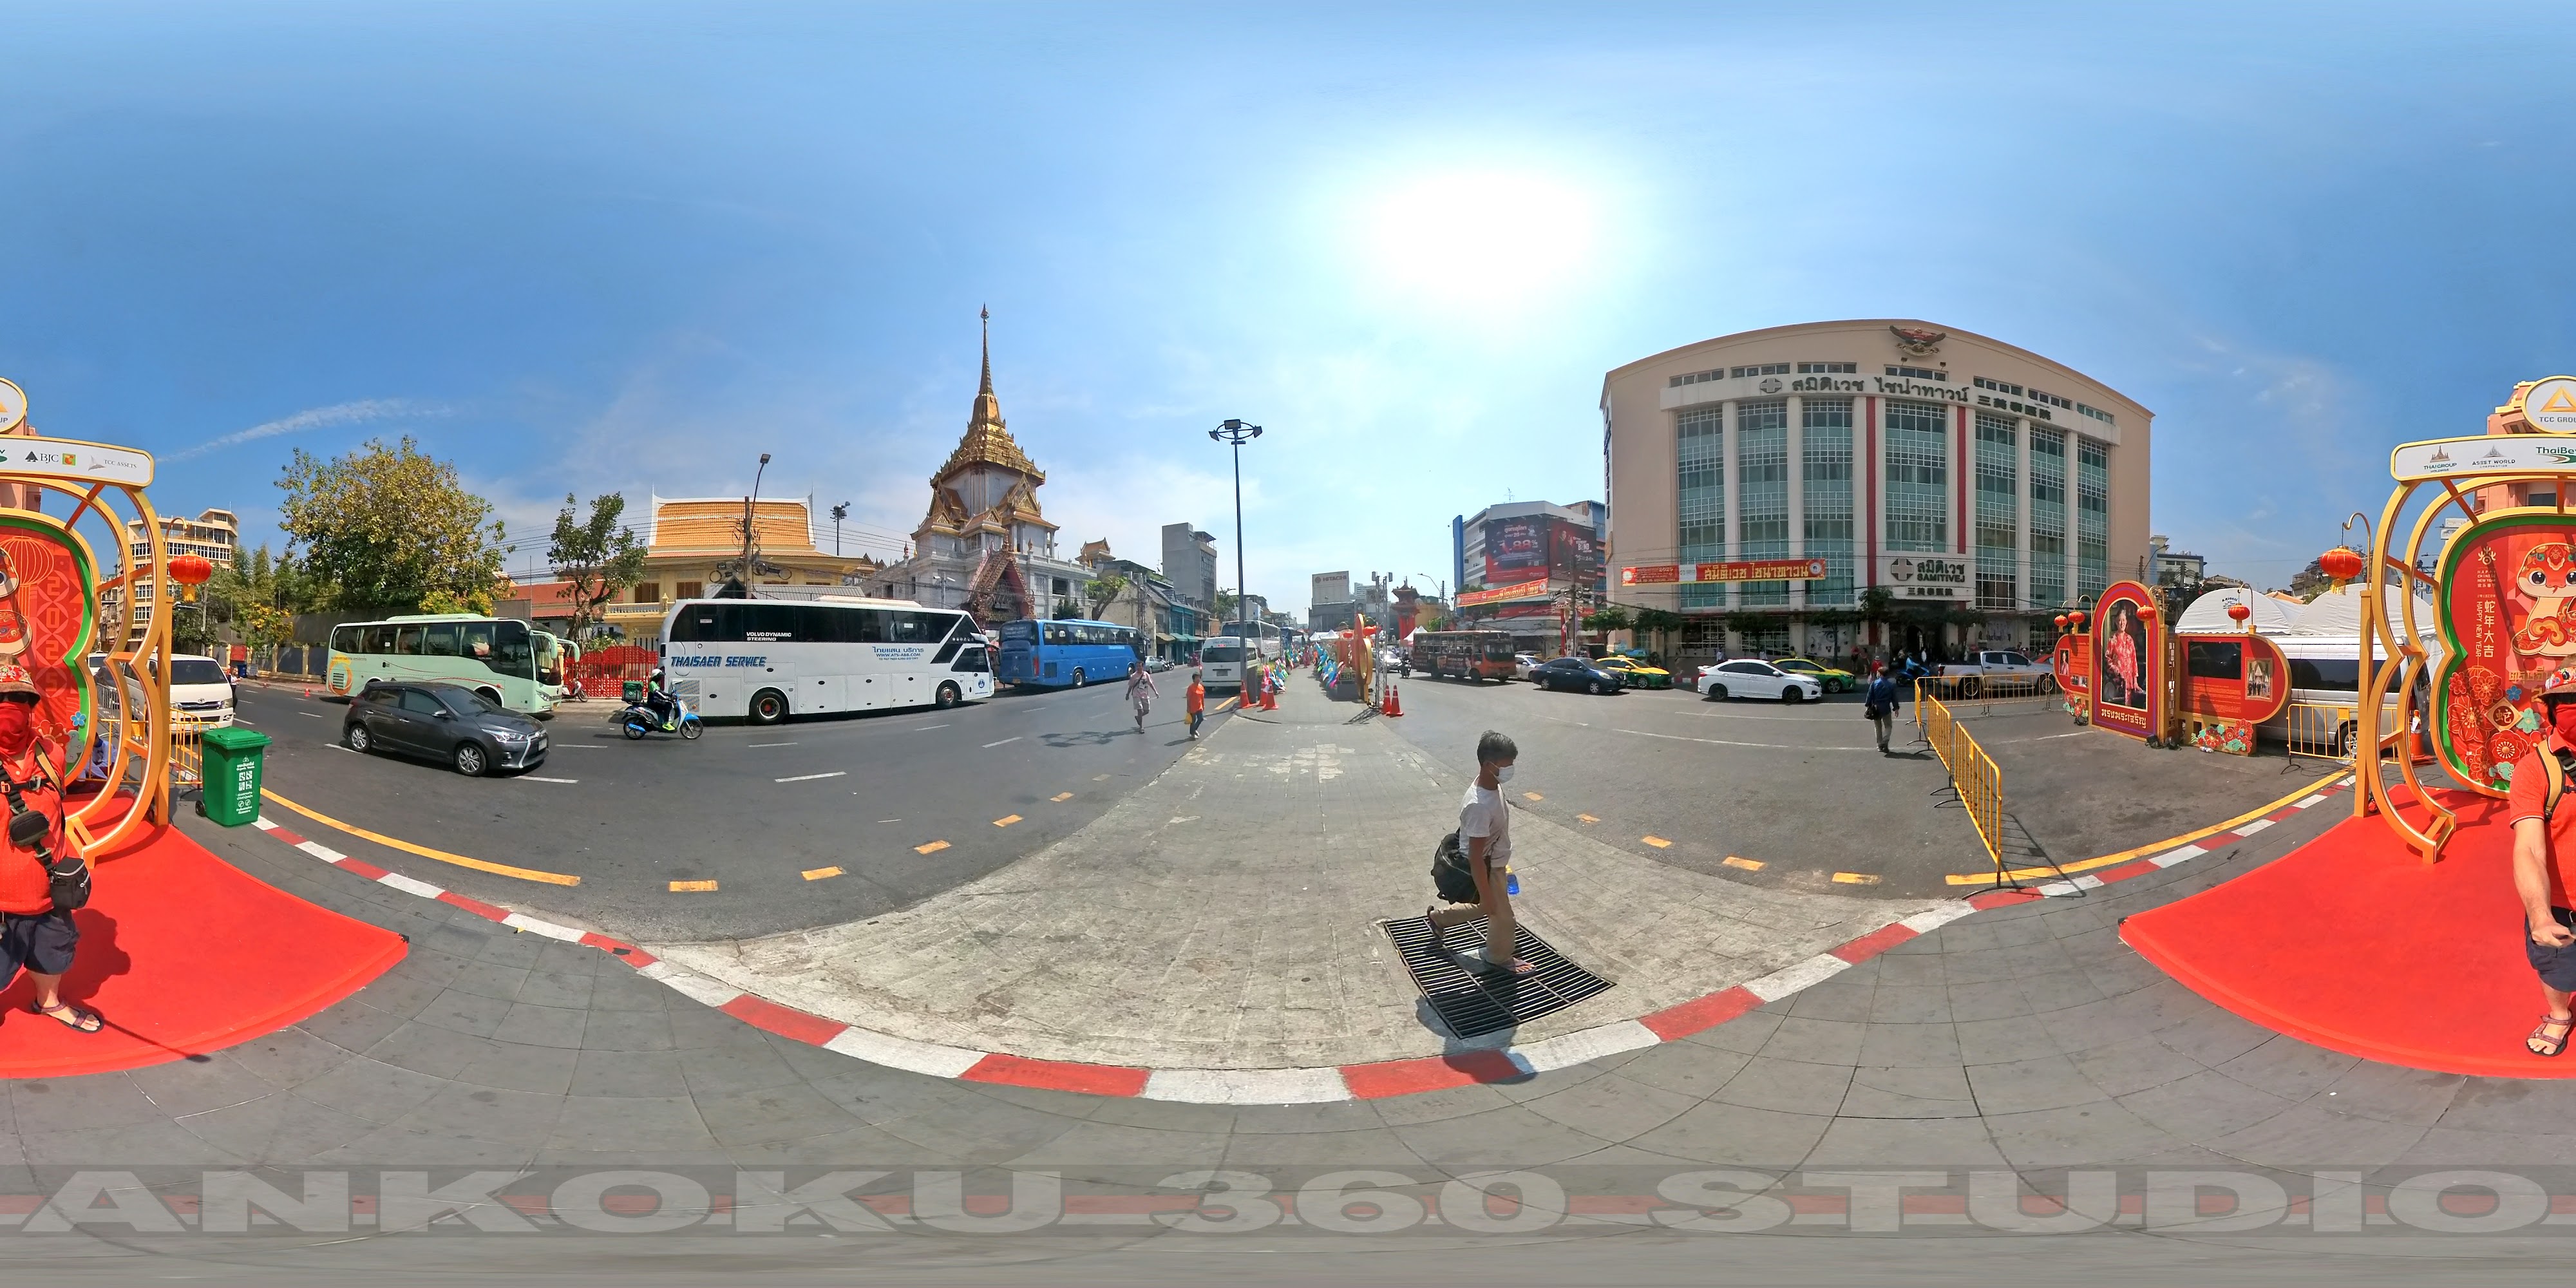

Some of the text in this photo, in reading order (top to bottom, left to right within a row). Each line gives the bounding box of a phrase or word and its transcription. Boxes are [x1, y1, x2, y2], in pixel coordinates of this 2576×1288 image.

[1792, 376, 1969, 402] สมิติเวช ไชน่าทาวน์
[40, 453, 59, 464] BJC
[1704, 565, 1747, 580] สมิติเวช
[1917, 559, 1965, 574] สมิติเวช
[1917, 573, 1965, 582] SAMITIVEJ
[2483, 600, 2496, 658] 蛇年大吉
[725, 656, 767, 668] SERVICE
[2101, 708, 2146, 729] ทรงพระเจริญ
[2496, 709, 2512, 724] 蛇
